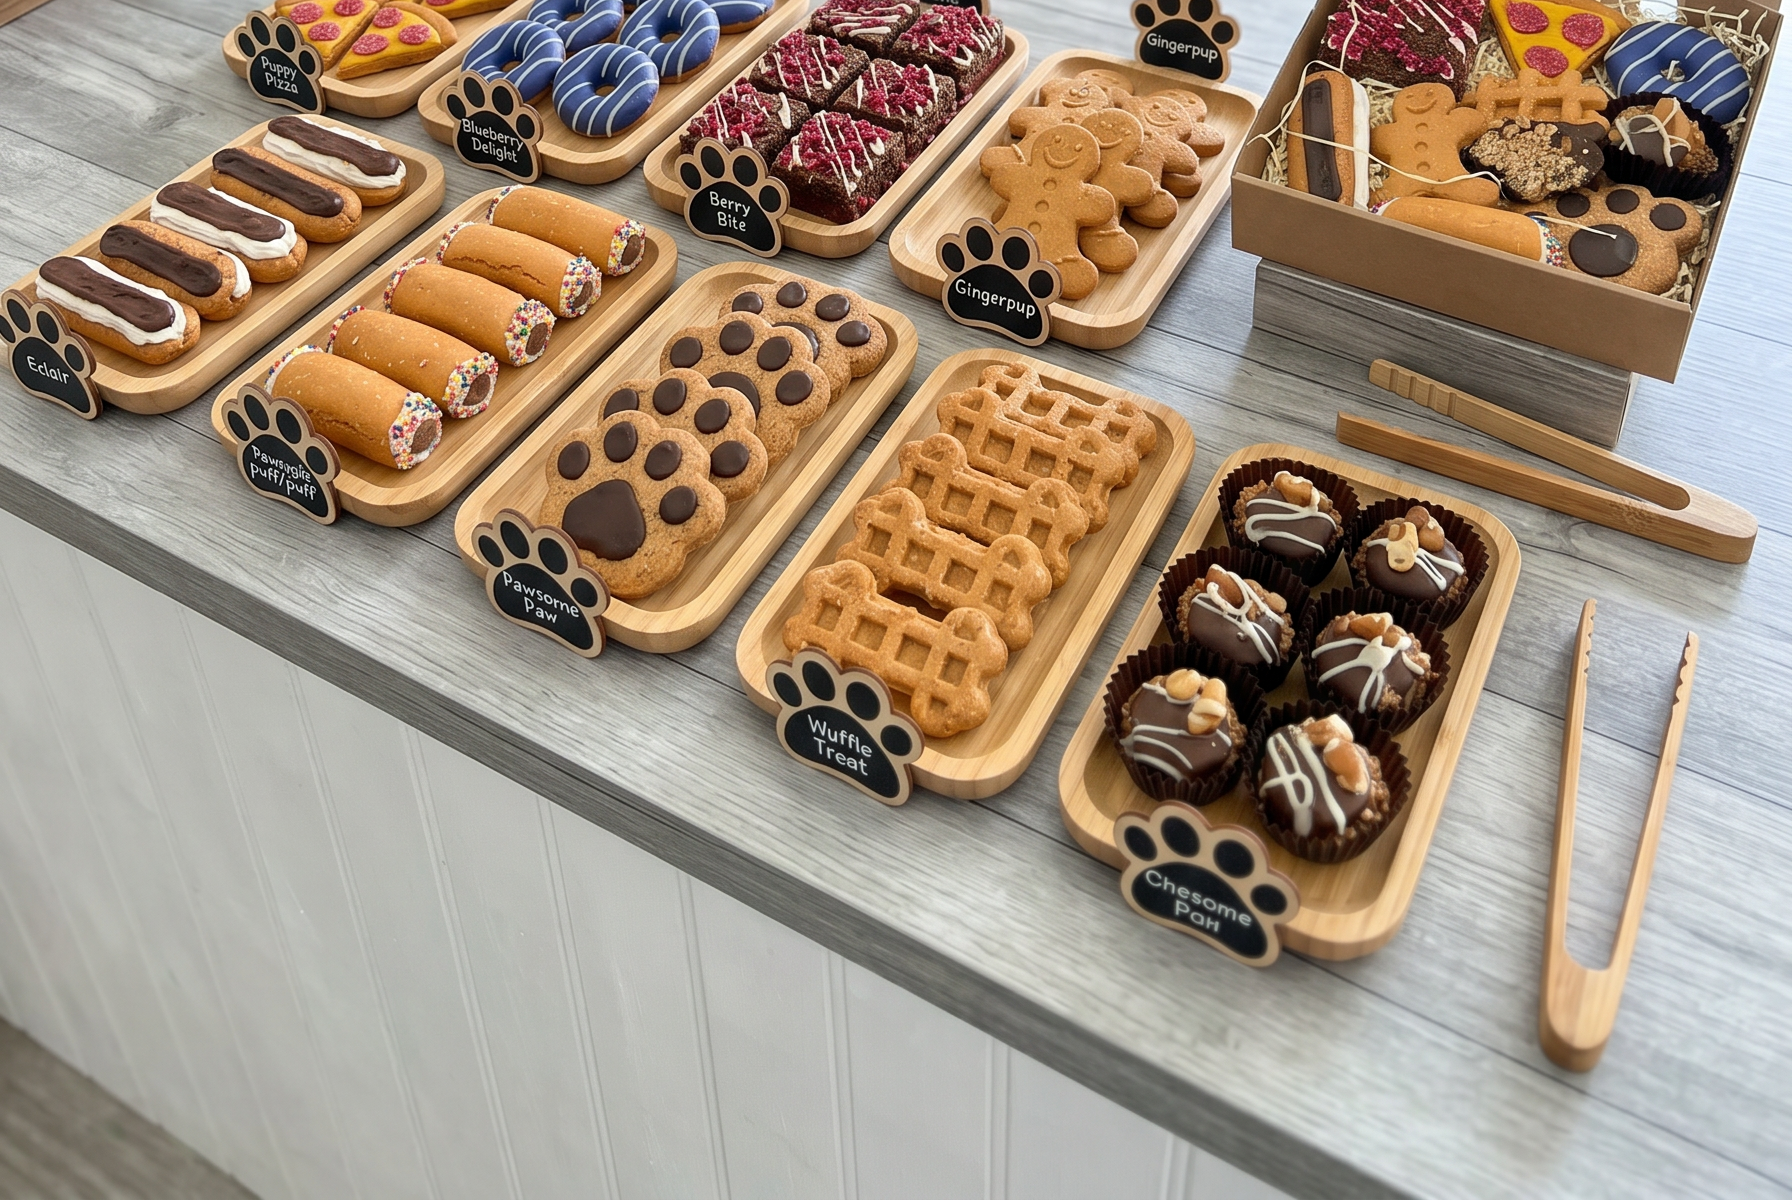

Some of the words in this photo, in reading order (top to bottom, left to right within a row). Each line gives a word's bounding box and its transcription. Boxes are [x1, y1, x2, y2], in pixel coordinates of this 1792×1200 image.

[1146, 33, 1218, 63] Gingerpup
[261, 55, 298, 81] Puppy
[265, 72, 299, 94] Pizza
[462, 118, 524, 152] Blueberry
[709, 191, 751, 217] Berry
[717, 211, 746, 232] Bite
[955, 279, 1036, 319] Gingerpup
[26, 355, 70, 384] Eclair
[523, 596, 558, 624] Paw
[807, 714, 873, 758] Wuffle
[813, 736, 868, 776] Treat
[1145, 869, 1253, 927] Chesome
